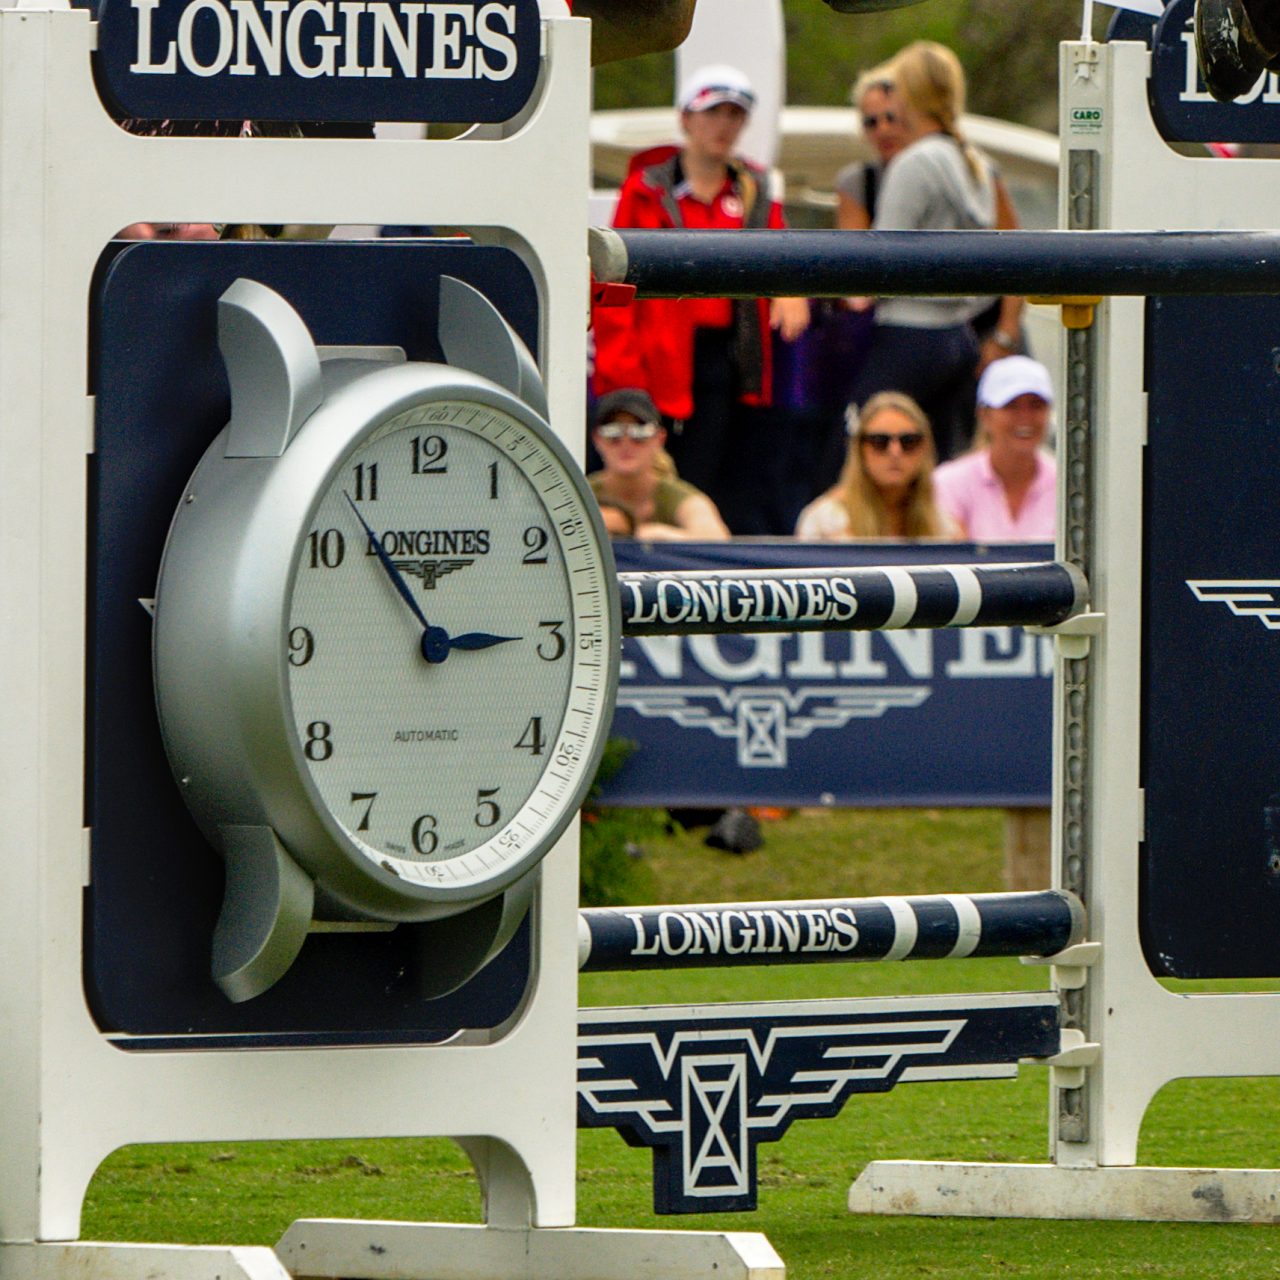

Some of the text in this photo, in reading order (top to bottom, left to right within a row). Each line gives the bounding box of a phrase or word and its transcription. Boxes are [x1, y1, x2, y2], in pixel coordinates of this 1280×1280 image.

[1073, 110, 1101, 121] CARO
[409, 435, 449, 475] 12
[353, 462, 378, 502] 11
[487, 461, 499, 500] 1
[308, 528, 346, 569] 10
[521, 526, 549, 565] 2
[624, 577, 860, 625] LONGINES
[287, 626, 315, 667] 9
[536, 621, 566, 662] 3
[303, 721, 334, 762] 8
[393, 729, 459, 743] AUTOMATIC
[513, 716, 547, 756] 4
[350, 792, 379, 831] 7
[474, 786, 501, 828] 5
[411, 814, 439, 855] 6
[625, 906, 860, 956] LONGINES
